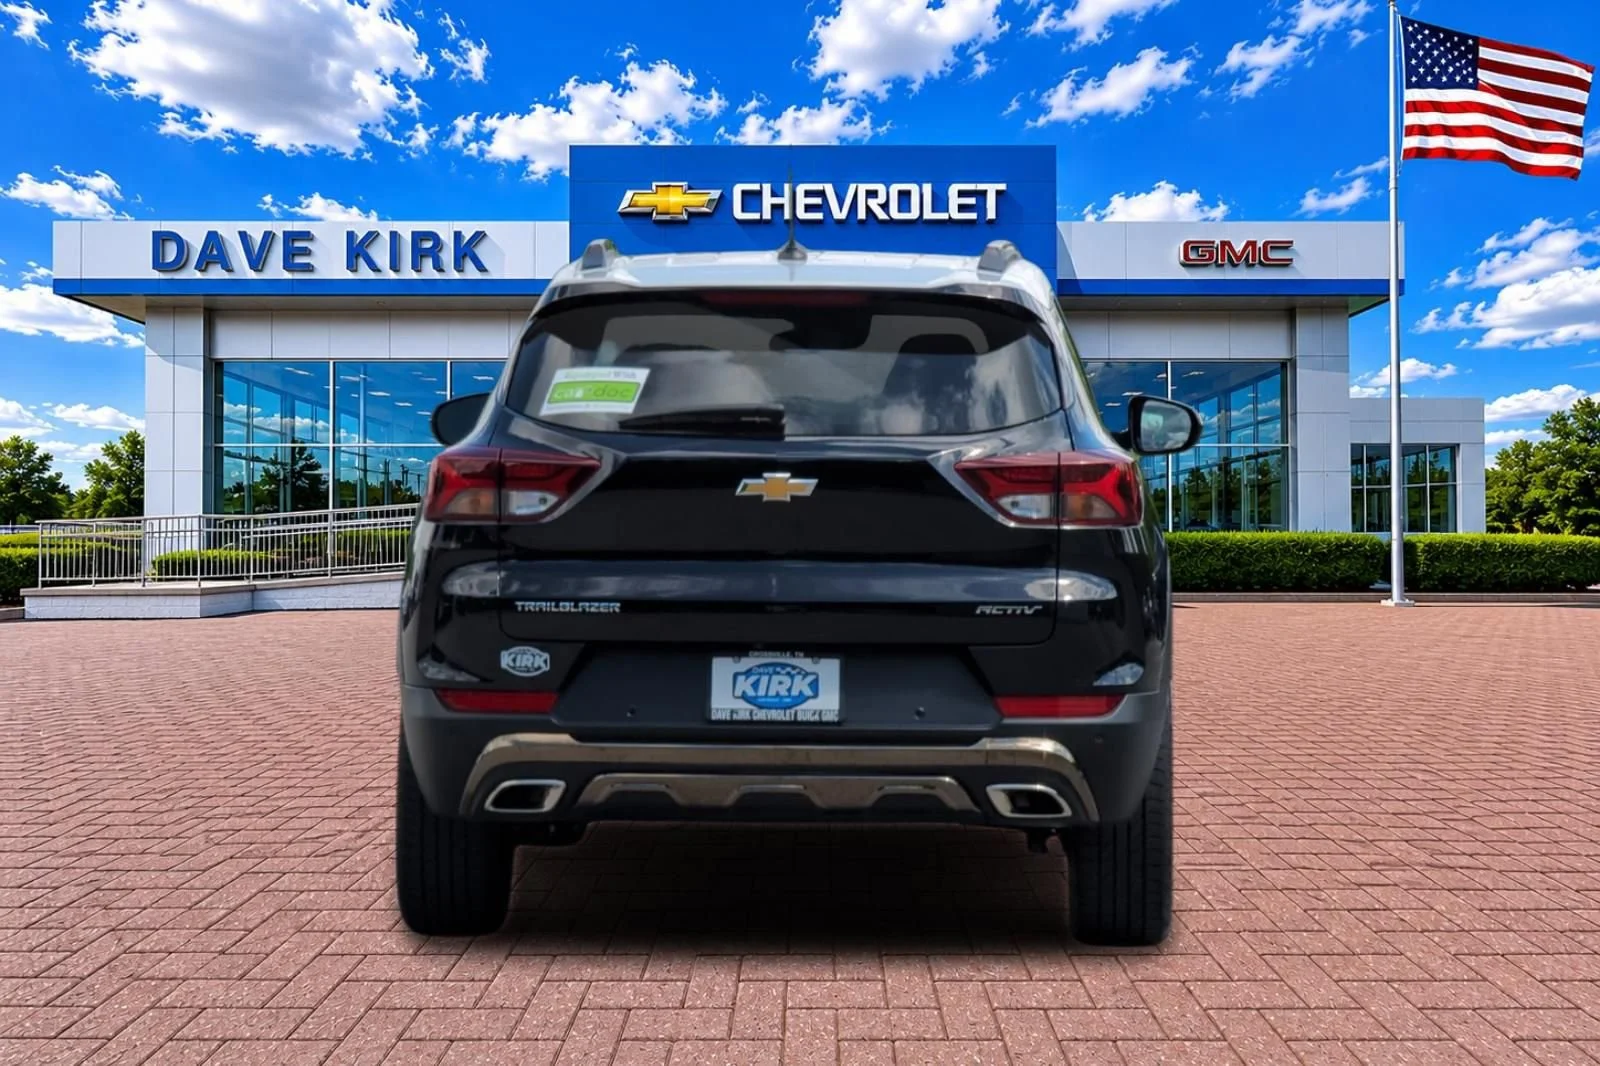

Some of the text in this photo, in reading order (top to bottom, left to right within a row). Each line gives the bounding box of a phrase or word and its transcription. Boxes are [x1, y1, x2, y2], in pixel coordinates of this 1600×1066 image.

[732, 183, 1007, 221] CHEVROLET
[151, 230, 489, 273] DAVE KIRK
[1180, 239, 1295, 267] GMC
[514, 601, 621, 613] TRAILBLAZER
[975, 605, 1043, 615] ACTIV
[501, 653, 546, 669] KIRK
[733, 674, 817, 698] KIRK
[752, 709, 796, 721] CHEVROLET
